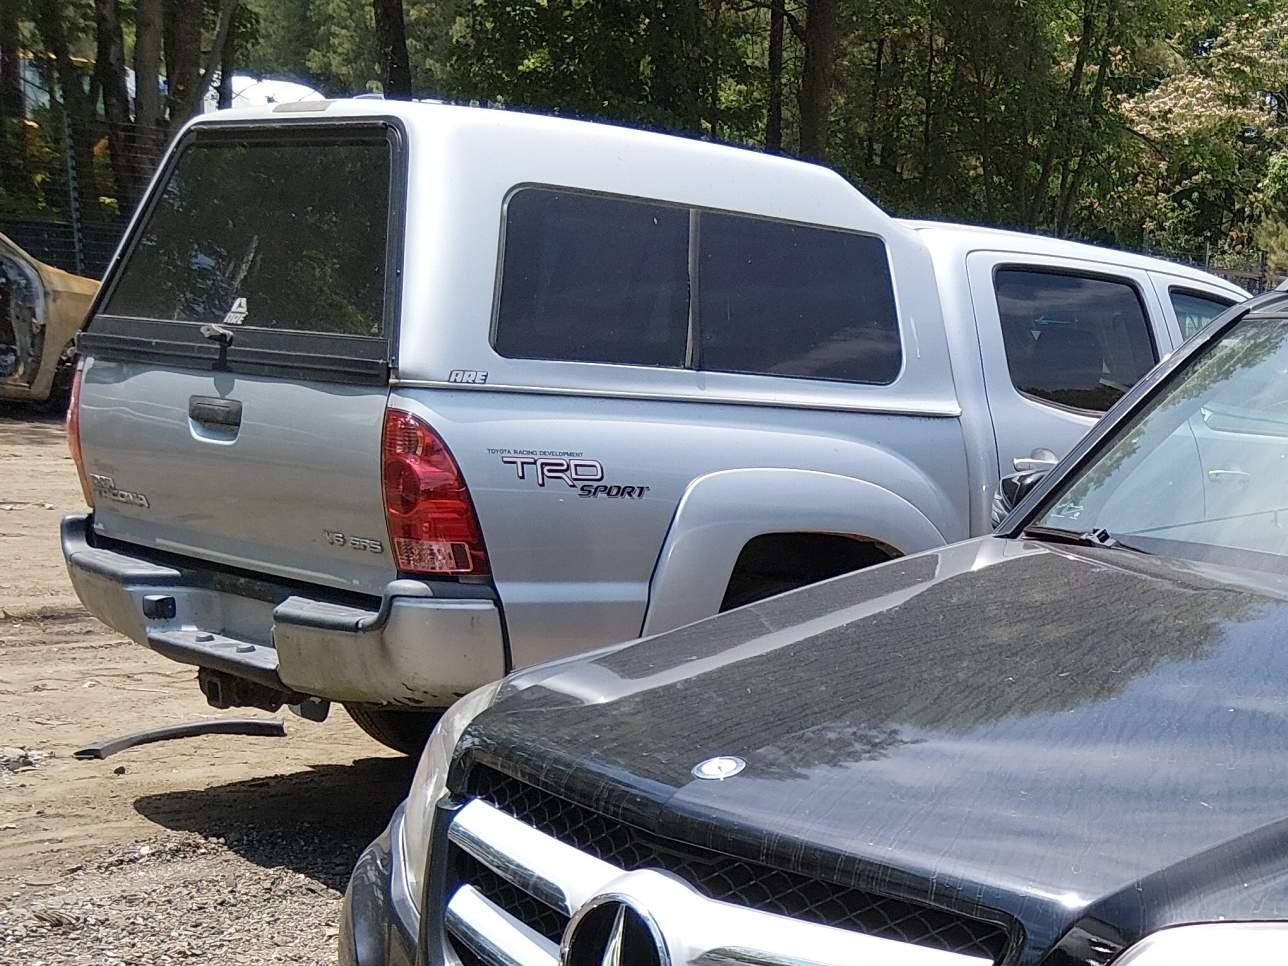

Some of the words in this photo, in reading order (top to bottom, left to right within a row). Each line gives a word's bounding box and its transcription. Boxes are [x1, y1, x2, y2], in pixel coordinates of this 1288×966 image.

[448, 369, 489, 385] ARE
[501, 456, 605, 488] TRD
[577, 484, 651, 500] SPORT
